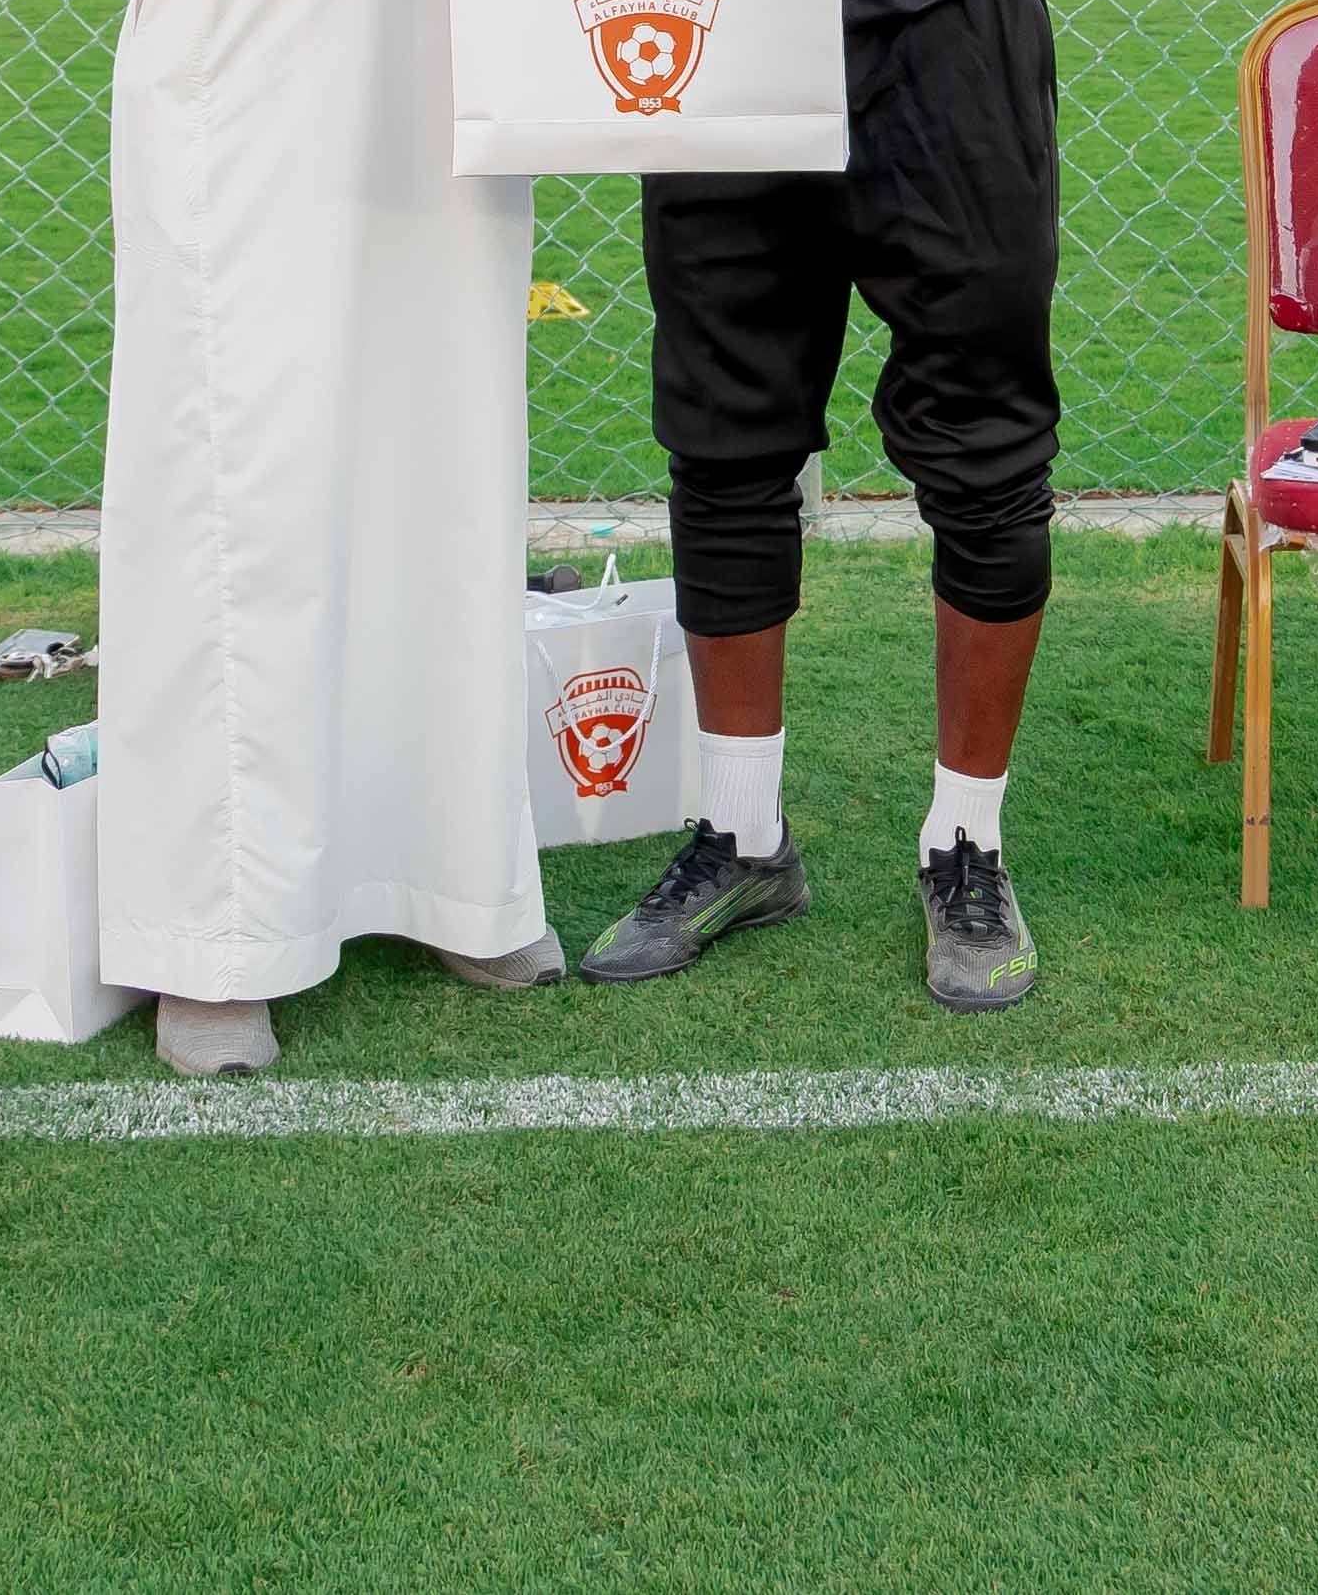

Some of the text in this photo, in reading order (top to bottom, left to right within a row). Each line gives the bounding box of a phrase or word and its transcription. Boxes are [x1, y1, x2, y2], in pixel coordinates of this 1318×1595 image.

[594, 1, 699, 23] ALFAYHA CLUB
[638, 98, 663, 109] 1953
[562, 708, 610, 727] AFAYHA
